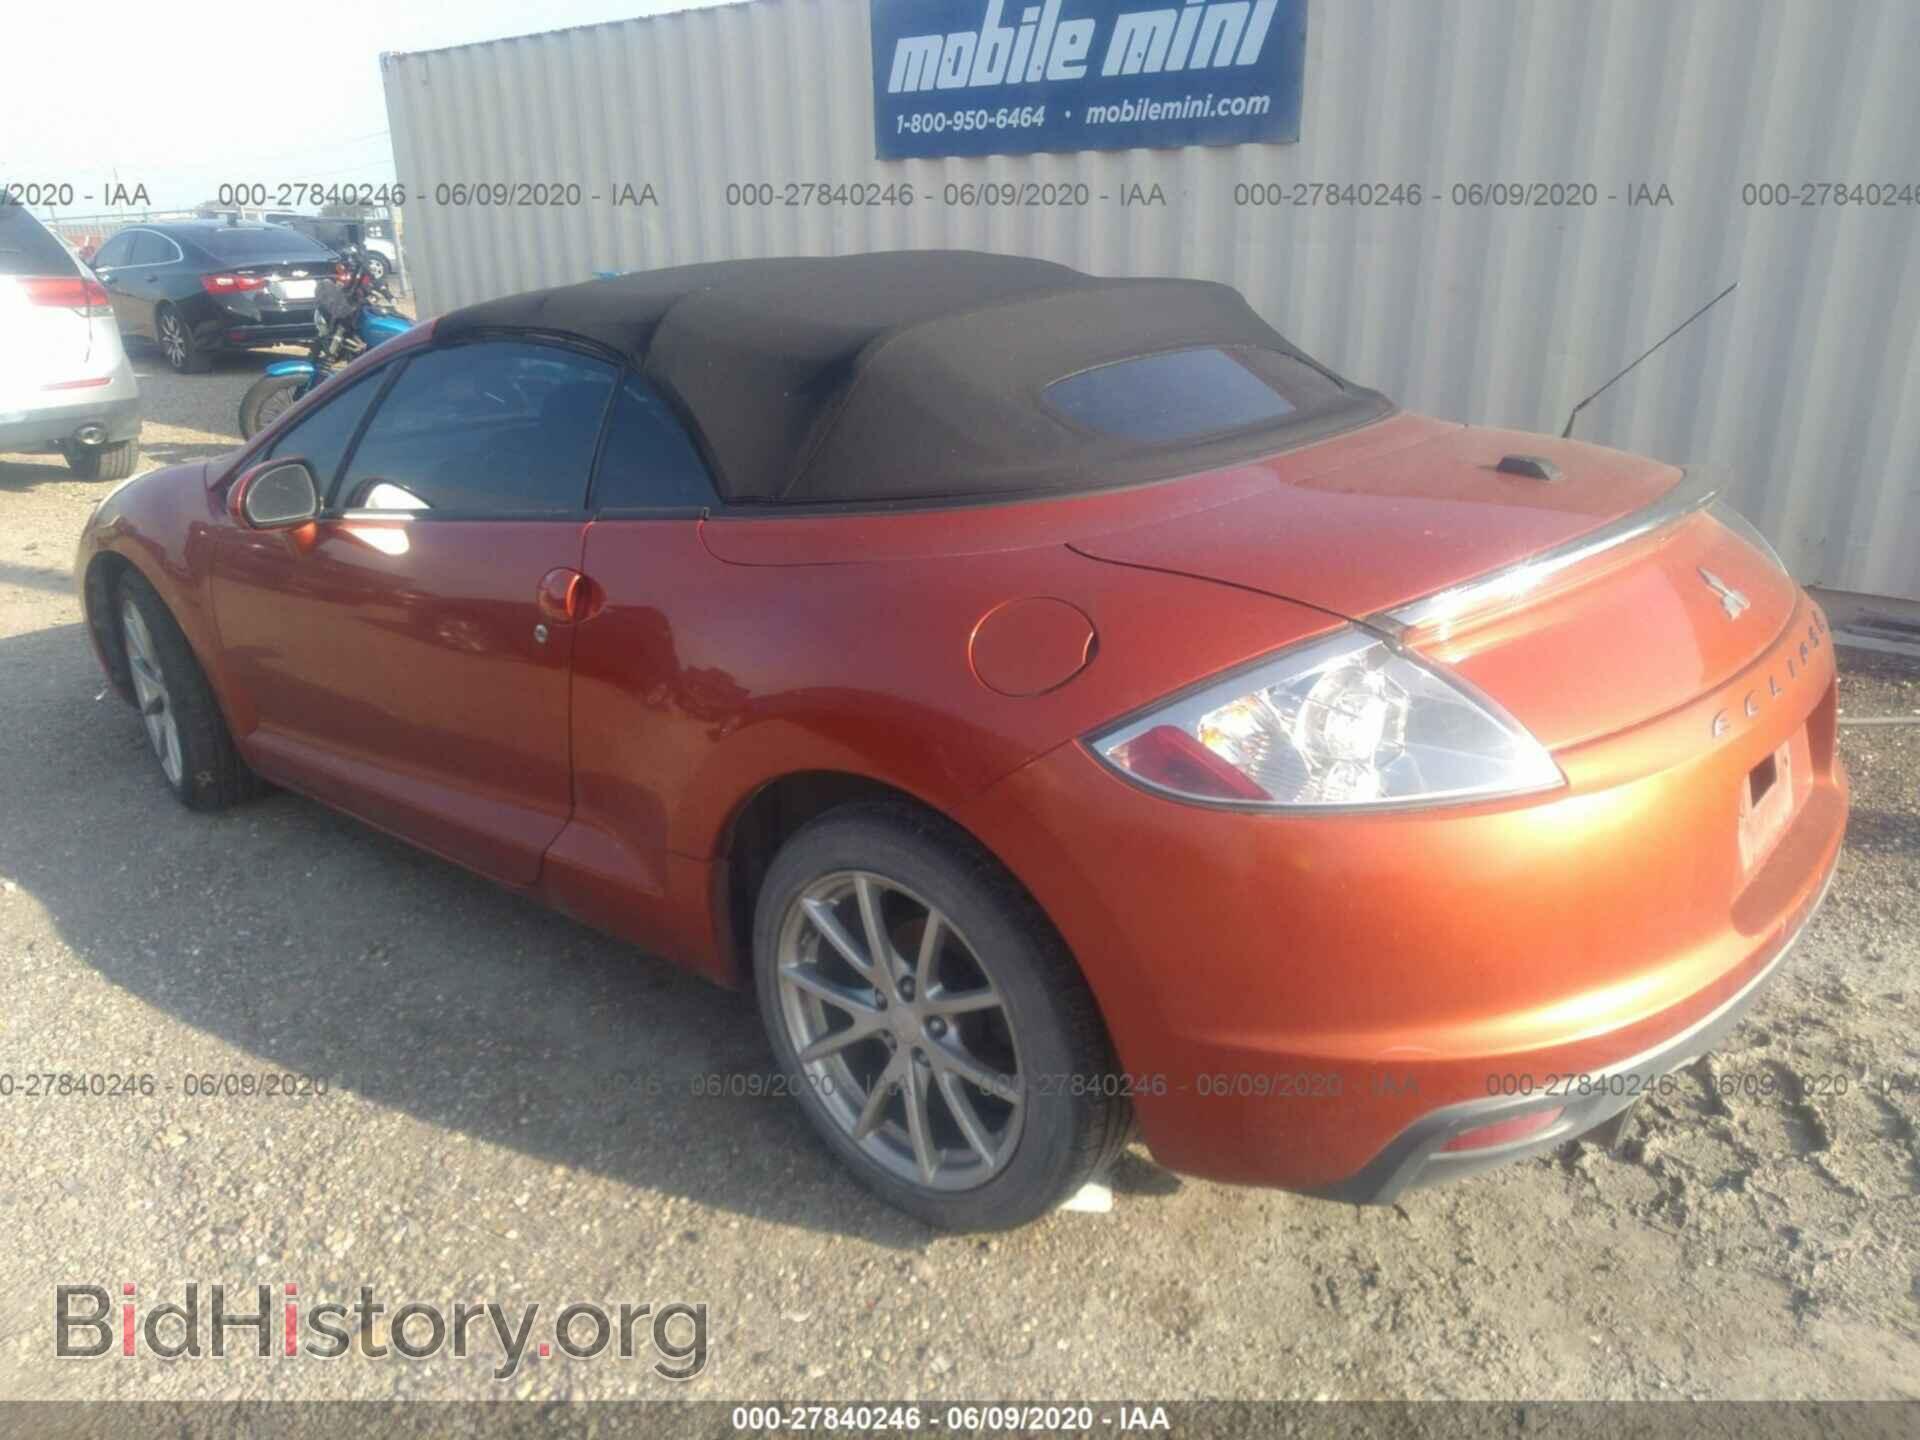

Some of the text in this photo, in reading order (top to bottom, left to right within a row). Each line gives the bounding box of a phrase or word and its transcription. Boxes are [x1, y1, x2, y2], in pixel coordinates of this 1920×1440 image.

[887, 0, 1278, 93] mobile mini
[896, 94, 1270, 134] 1-800-950-6464 mobilemini.com
